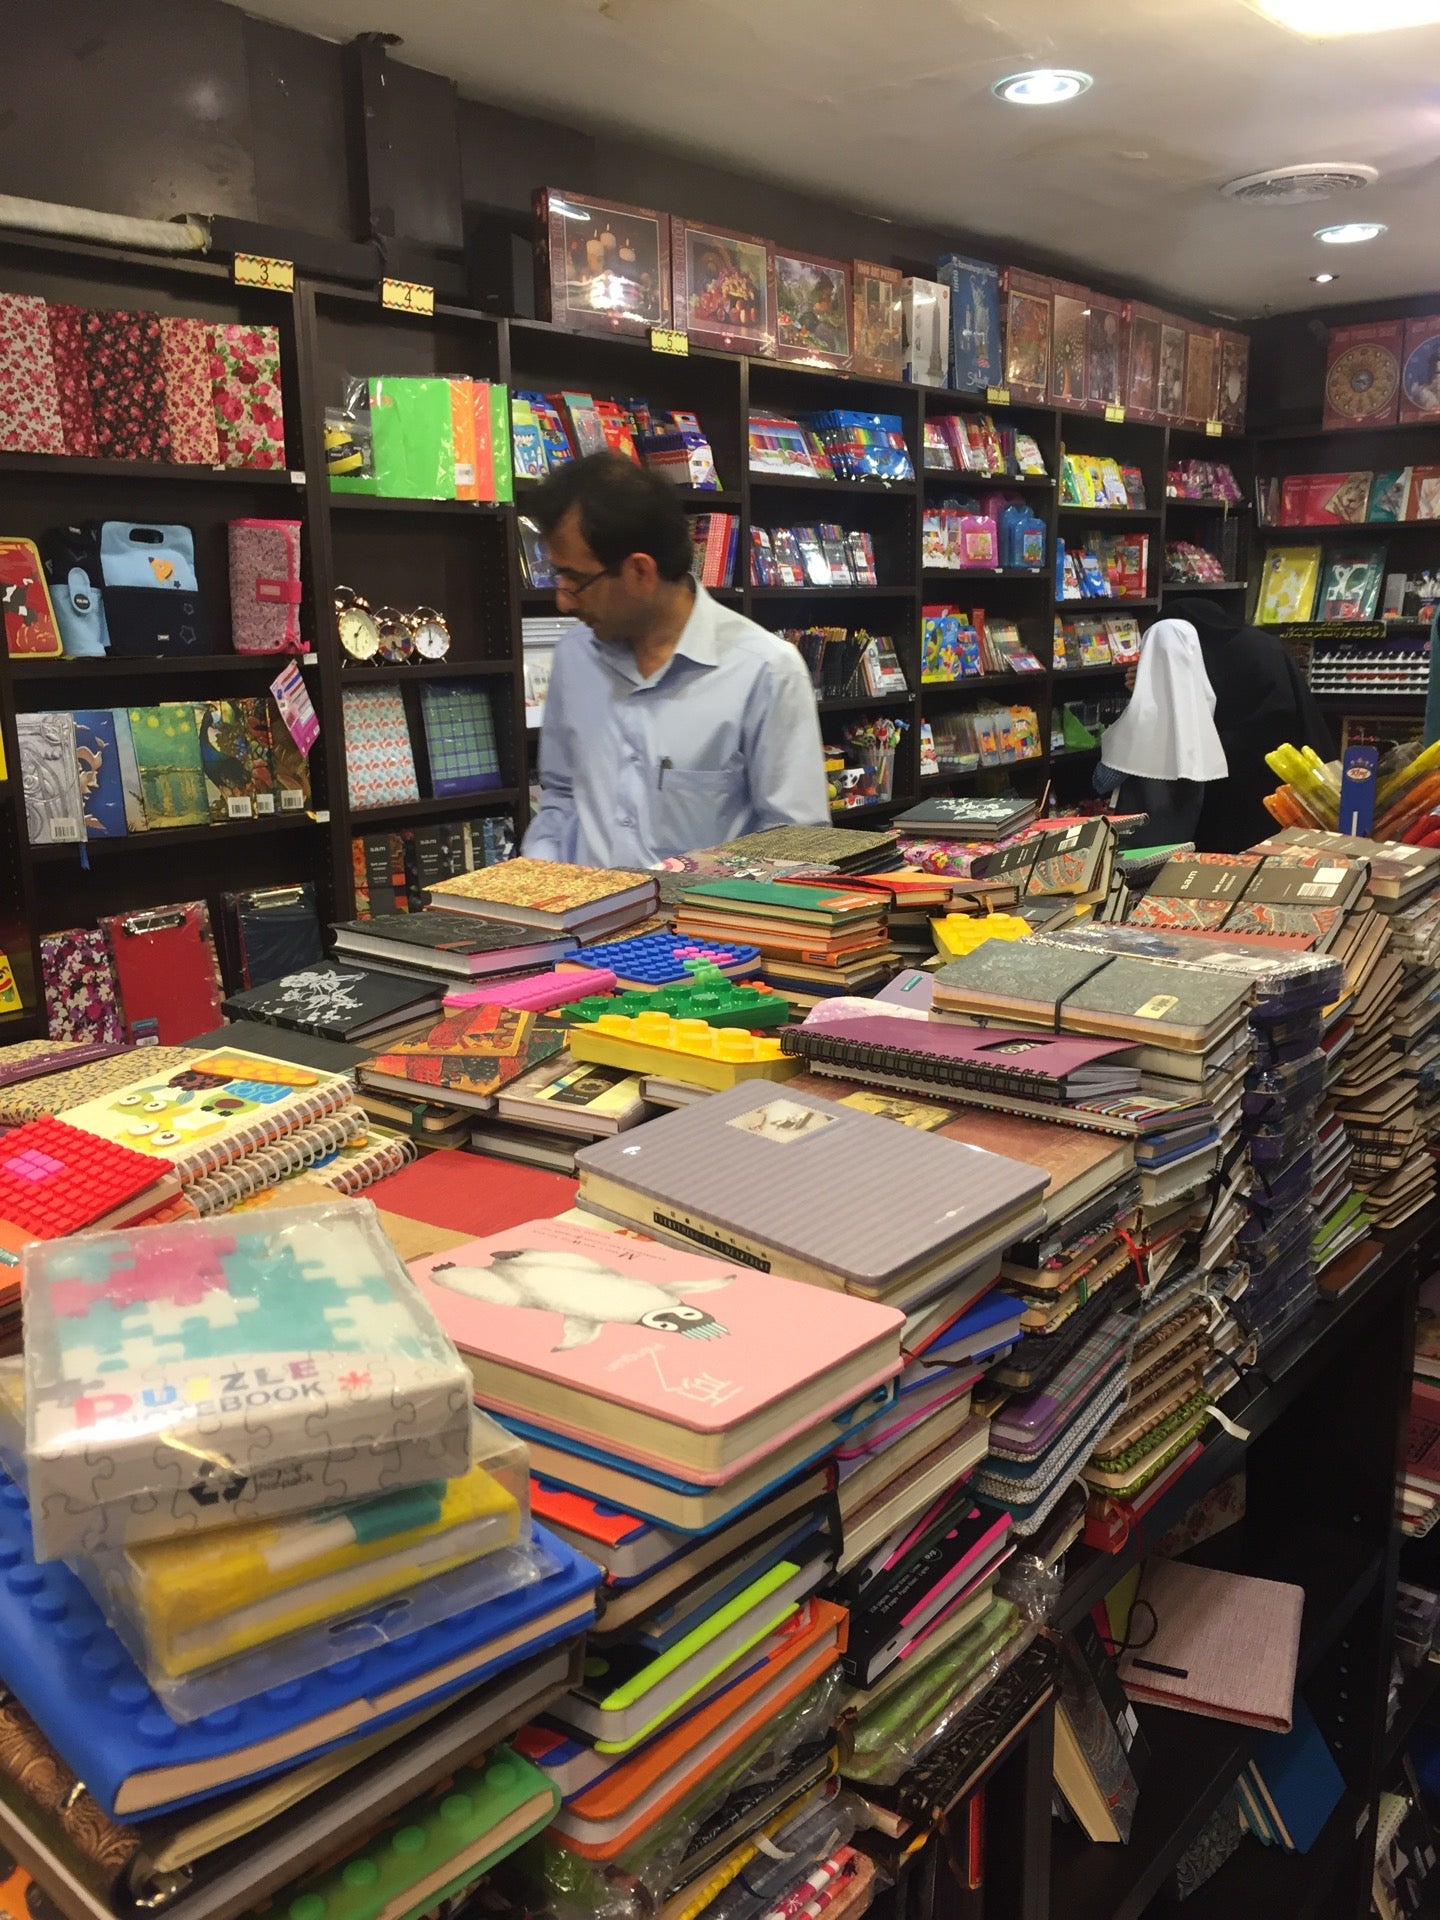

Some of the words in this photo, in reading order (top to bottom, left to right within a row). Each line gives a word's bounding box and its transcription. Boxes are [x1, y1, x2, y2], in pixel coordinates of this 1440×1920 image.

[259, 263, 270, 282] 3
[404, 288, 412, 307] 4
[666, 336, 674, 350] 5
[1180, 870, 1197, 890] sam
